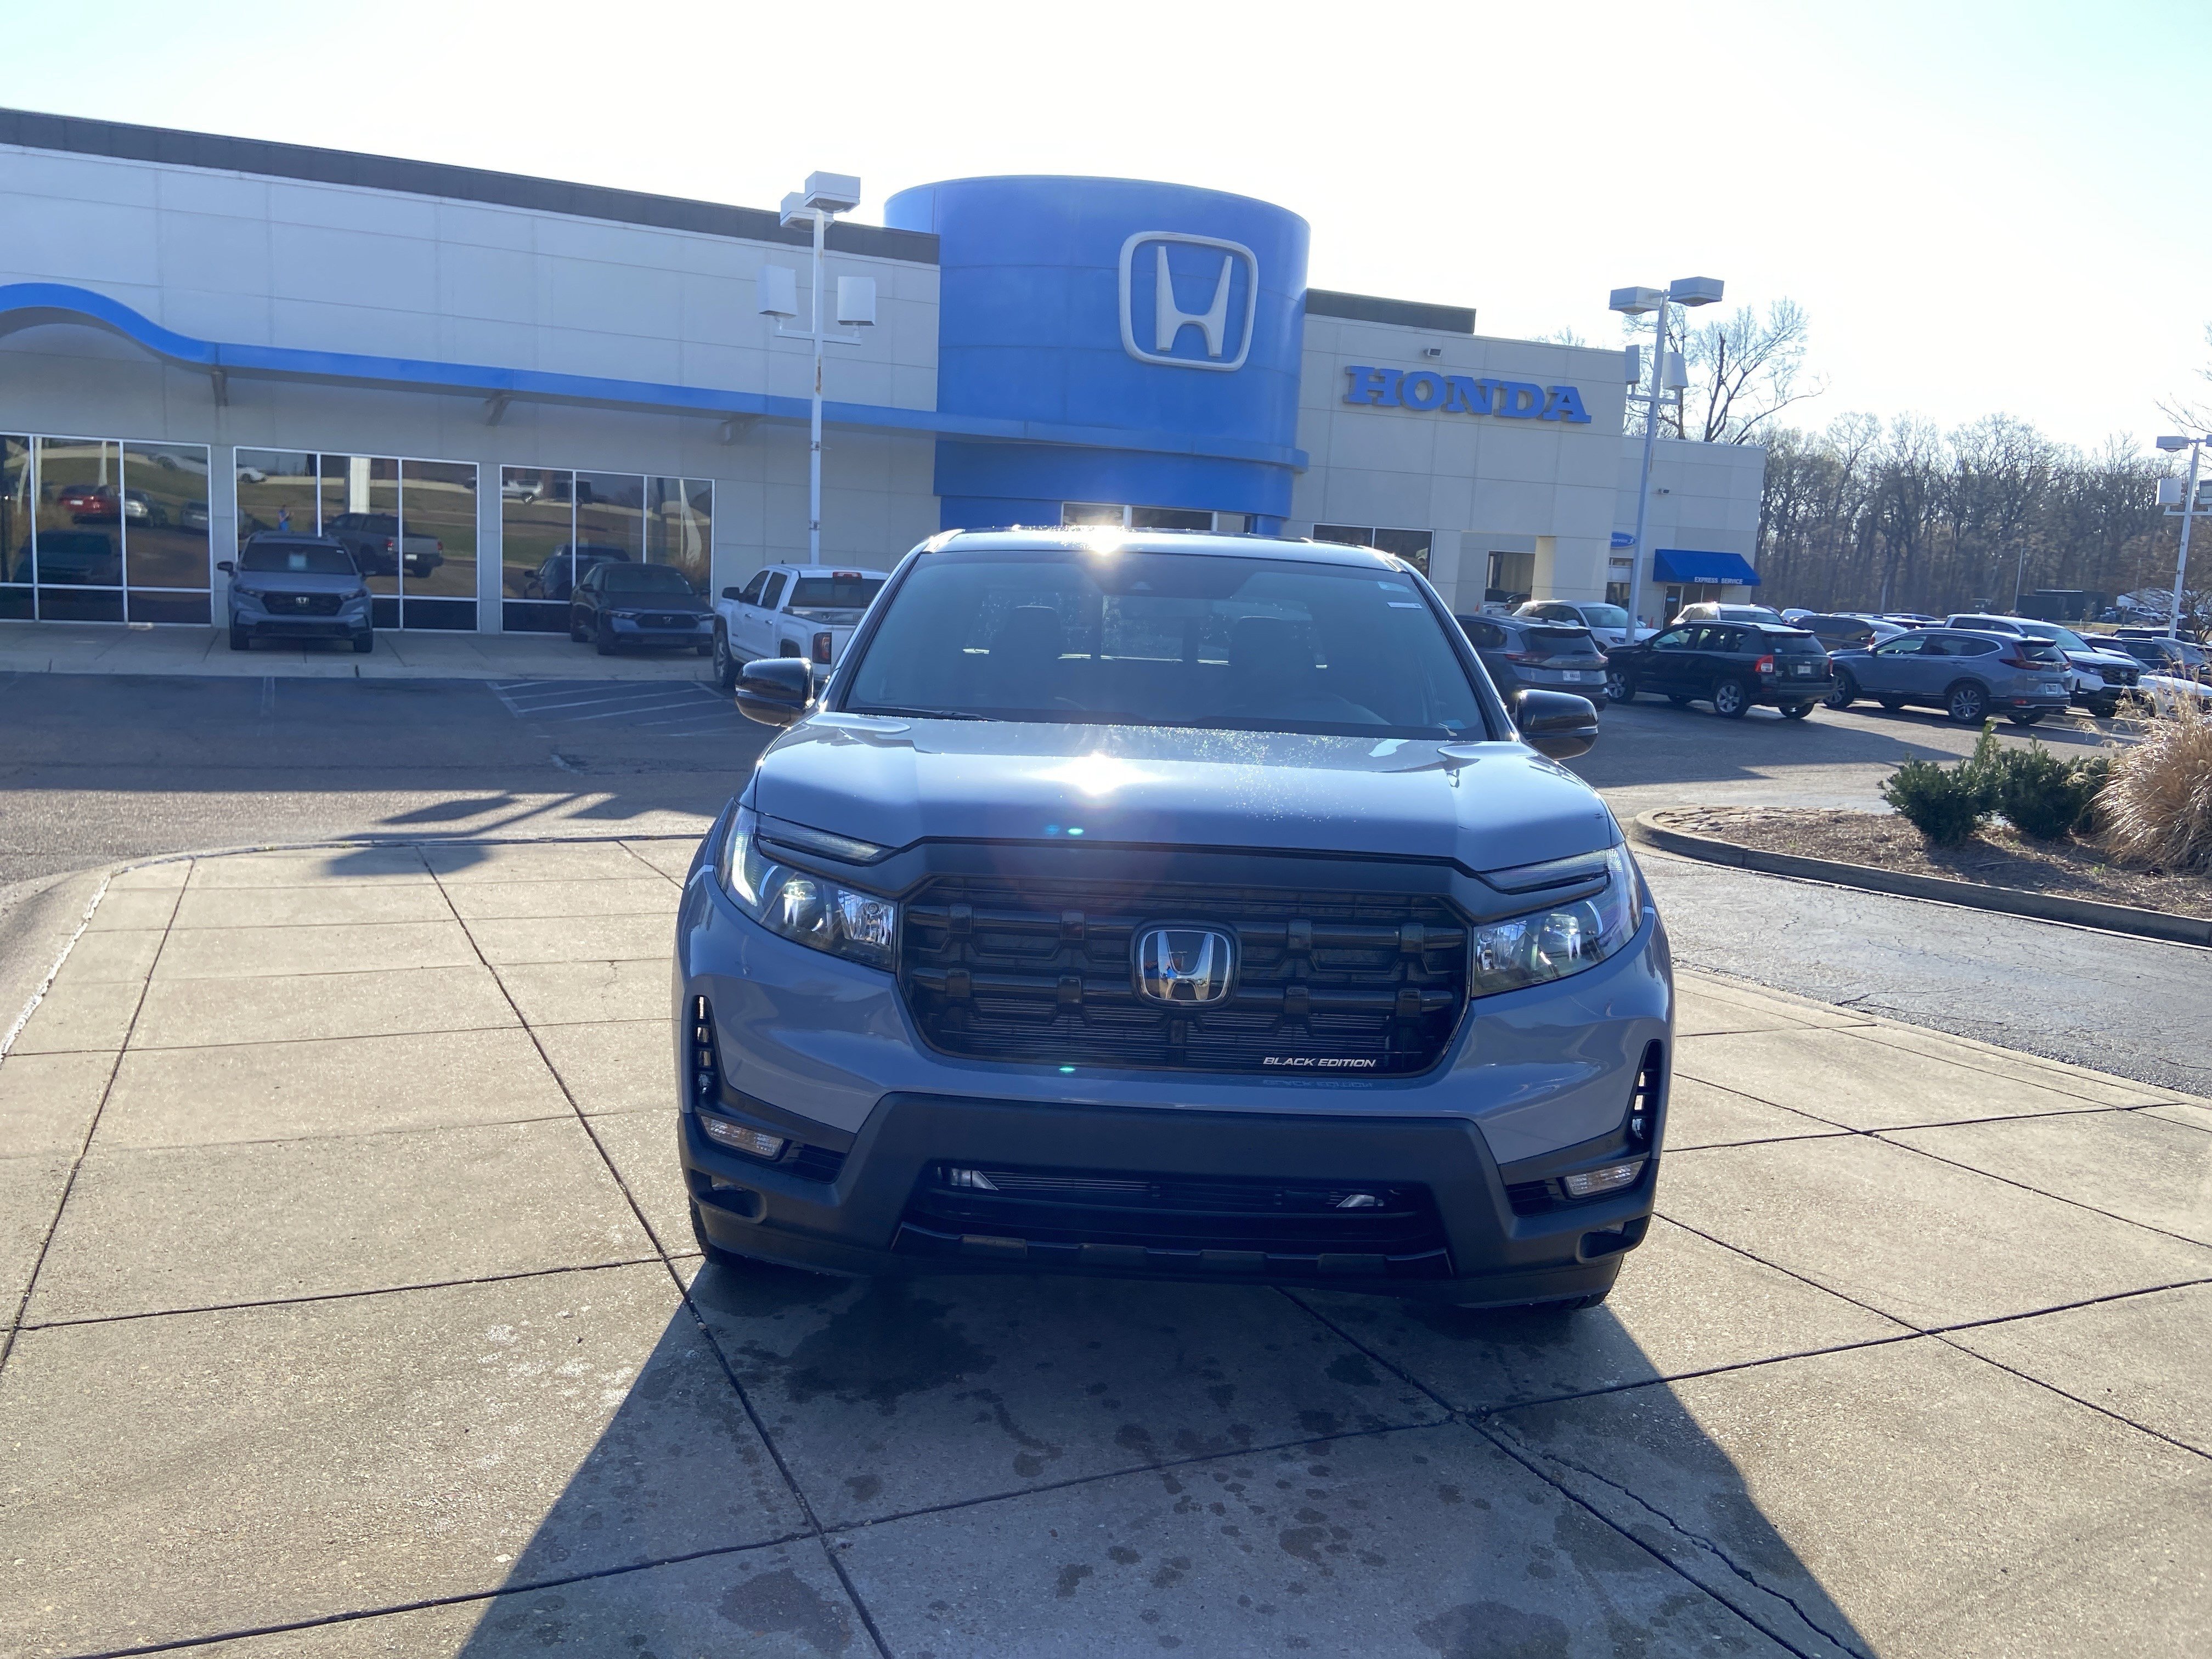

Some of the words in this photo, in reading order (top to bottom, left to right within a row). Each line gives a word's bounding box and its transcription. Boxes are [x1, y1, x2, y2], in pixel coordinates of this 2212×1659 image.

[1342, 365, 1592, 424] HONDA
[1263, 1057, 1316, 1066] BLACK
[1318, 1058, 1377, 1068] EDITION
